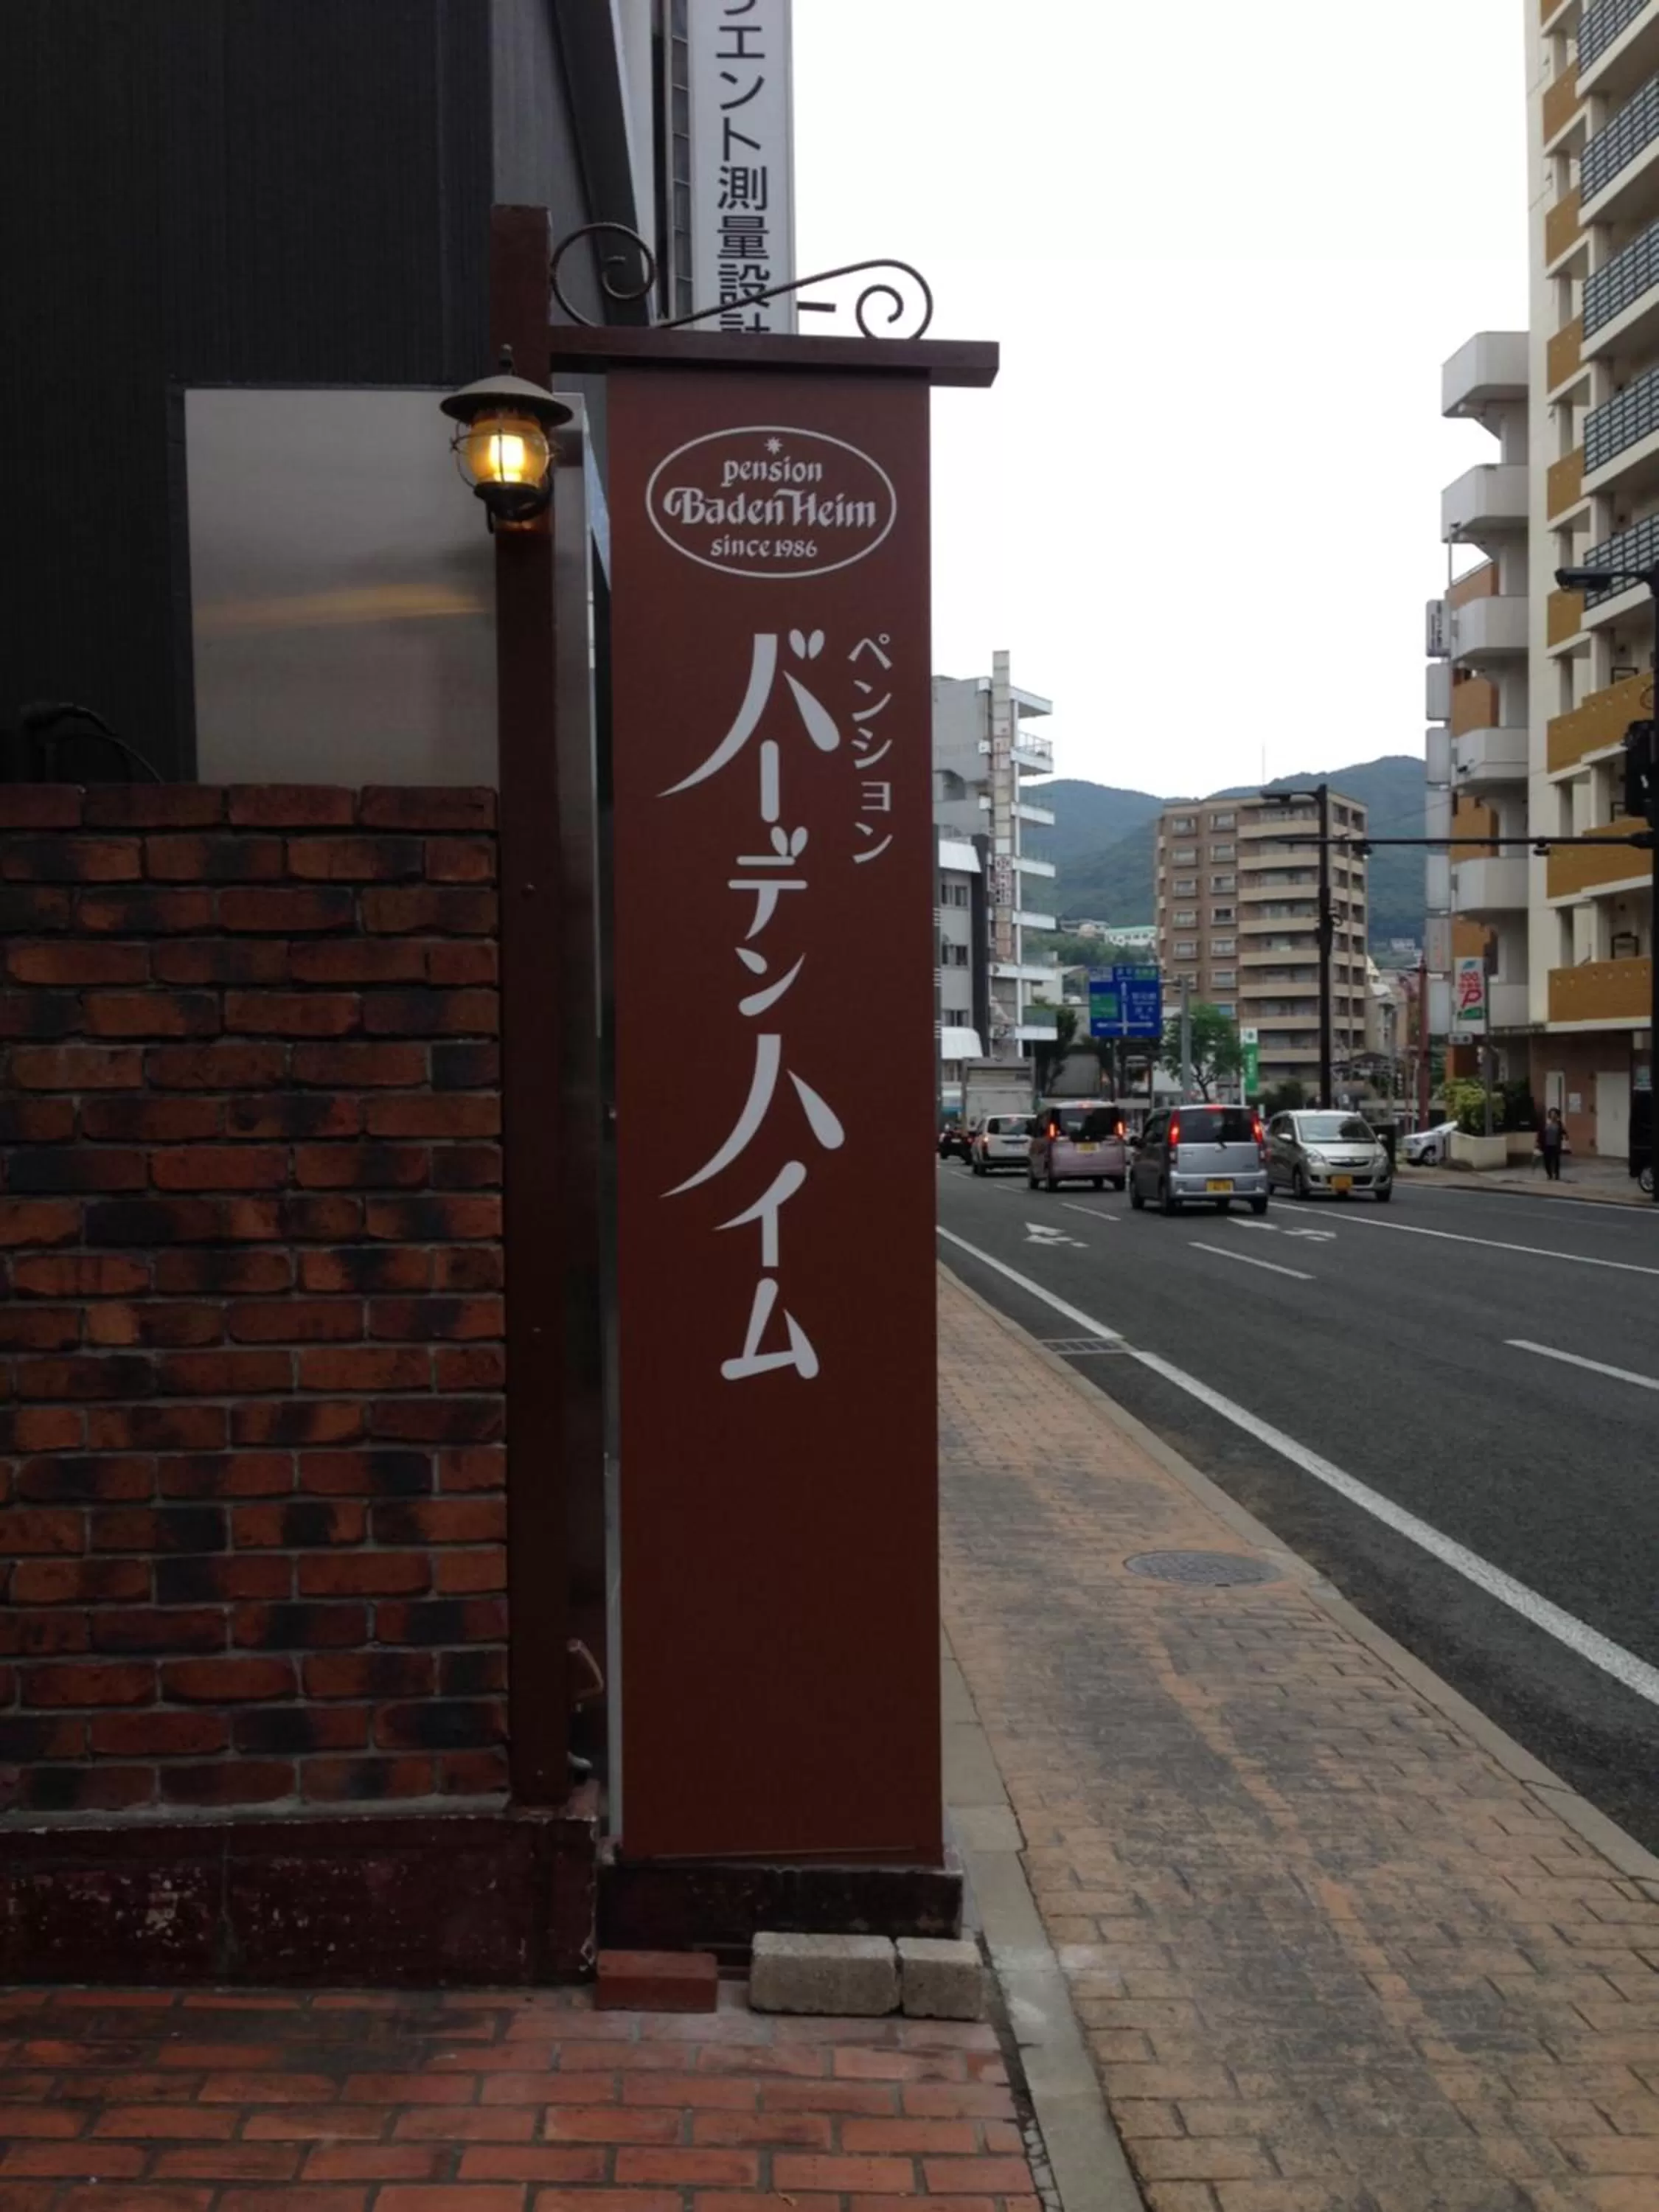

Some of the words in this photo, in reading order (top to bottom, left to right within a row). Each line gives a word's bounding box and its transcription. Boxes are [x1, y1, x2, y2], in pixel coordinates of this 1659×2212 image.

[720, 456, 823, 487] pension
[710, 534, 771, 558] since
[773, 538, 818, 558] 1986
[655, 628, 845, 1381] バーデンハイム
